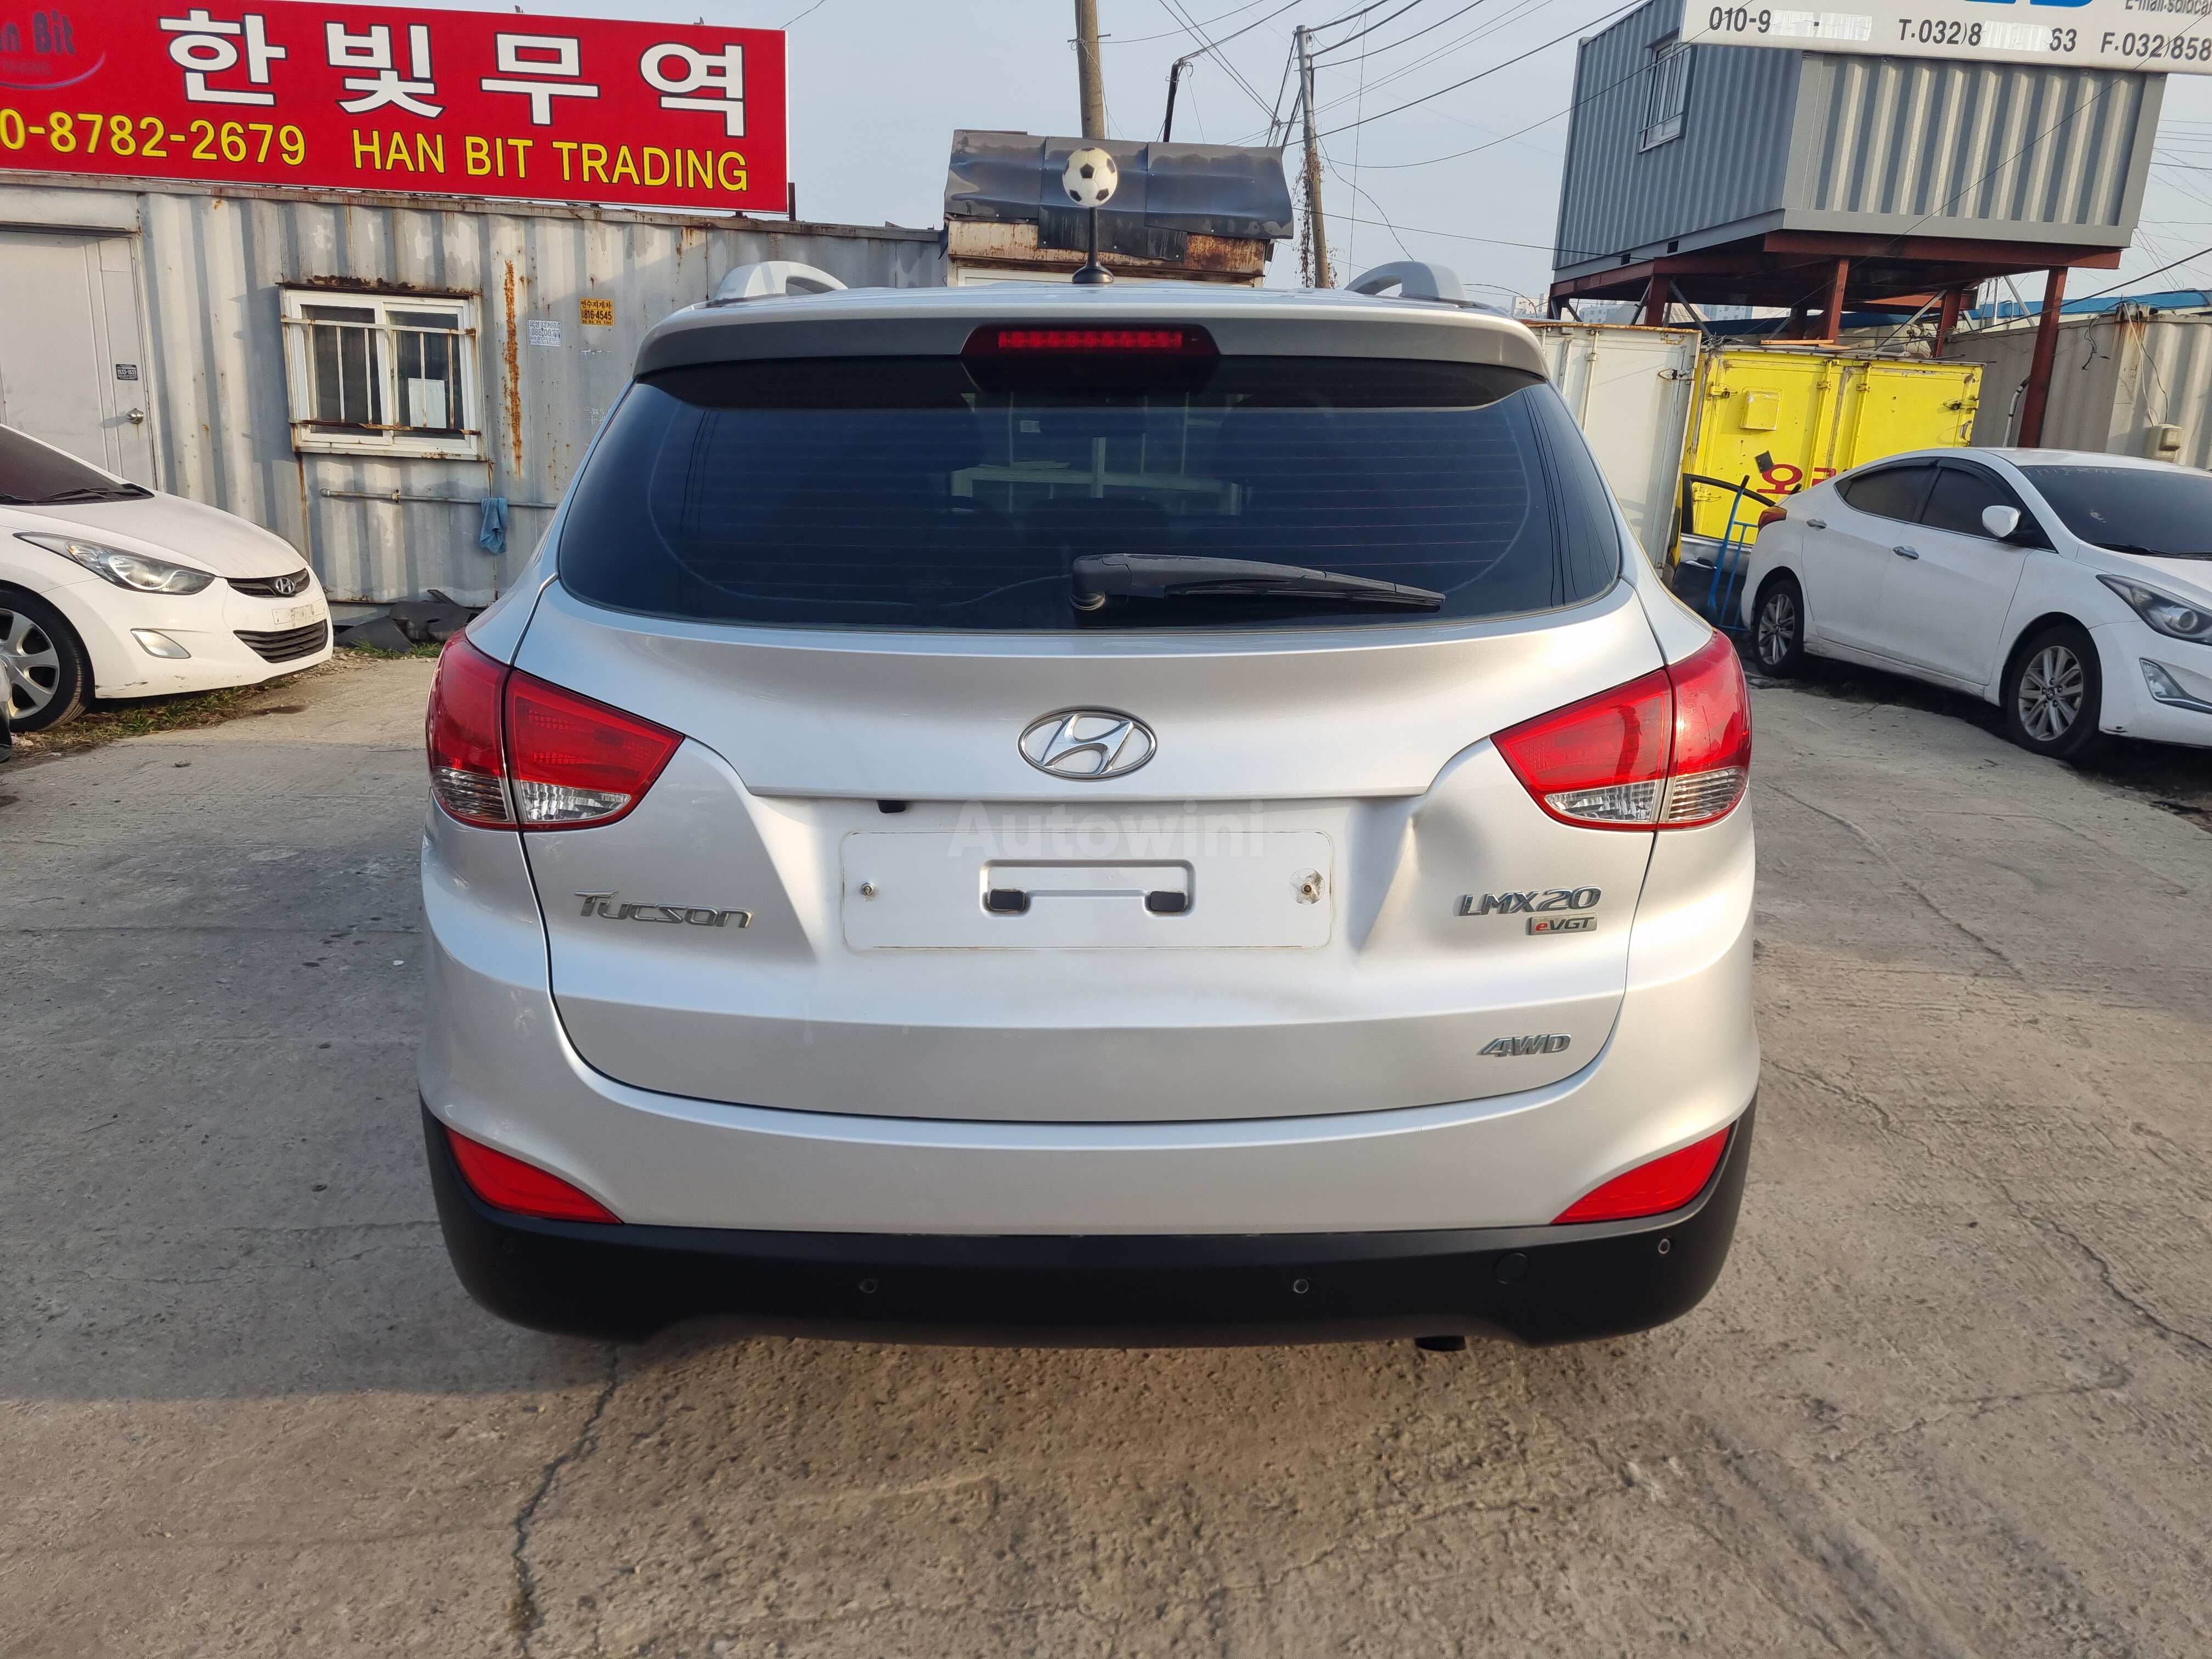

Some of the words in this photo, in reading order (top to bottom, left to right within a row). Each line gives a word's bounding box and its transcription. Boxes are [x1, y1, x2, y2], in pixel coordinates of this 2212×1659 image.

[33, 9, 75, 55] Bit
[352, 128, 445, 173] HAN
[465, 136, 534, 178] BIT
[552, 140, 747, 191] TRADING
[1458, 886, 1602, 917] LMX20
[1536, 916, 1595, 932] eVGT
[1476, 1032, 1572, 1058] 4WD
